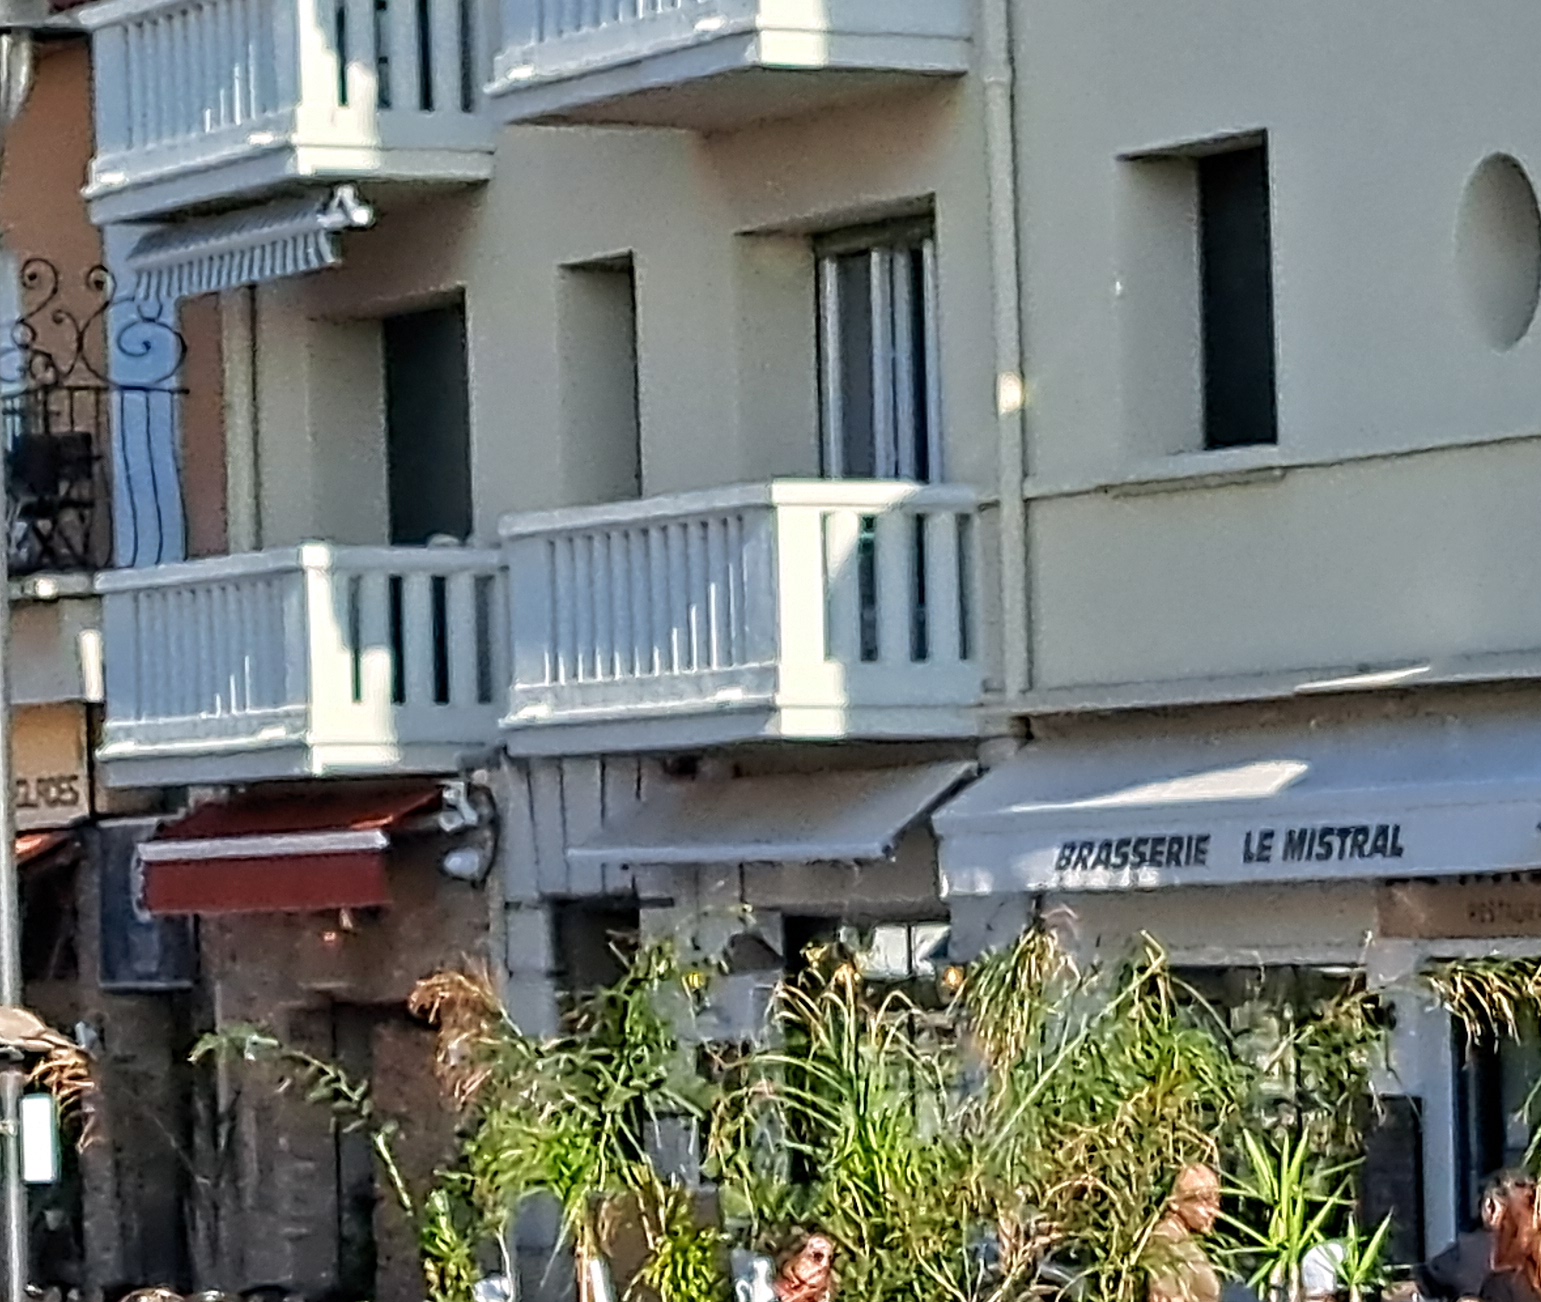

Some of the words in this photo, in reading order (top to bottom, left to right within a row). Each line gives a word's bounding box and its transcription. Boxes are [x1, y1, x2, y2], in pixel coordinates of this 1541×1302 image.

[1054, 833, 1212, 872] BRASSERIE
[1242, 828, 1276, 865] LE
[1282, 823, 1404, 863] MISTRAL
